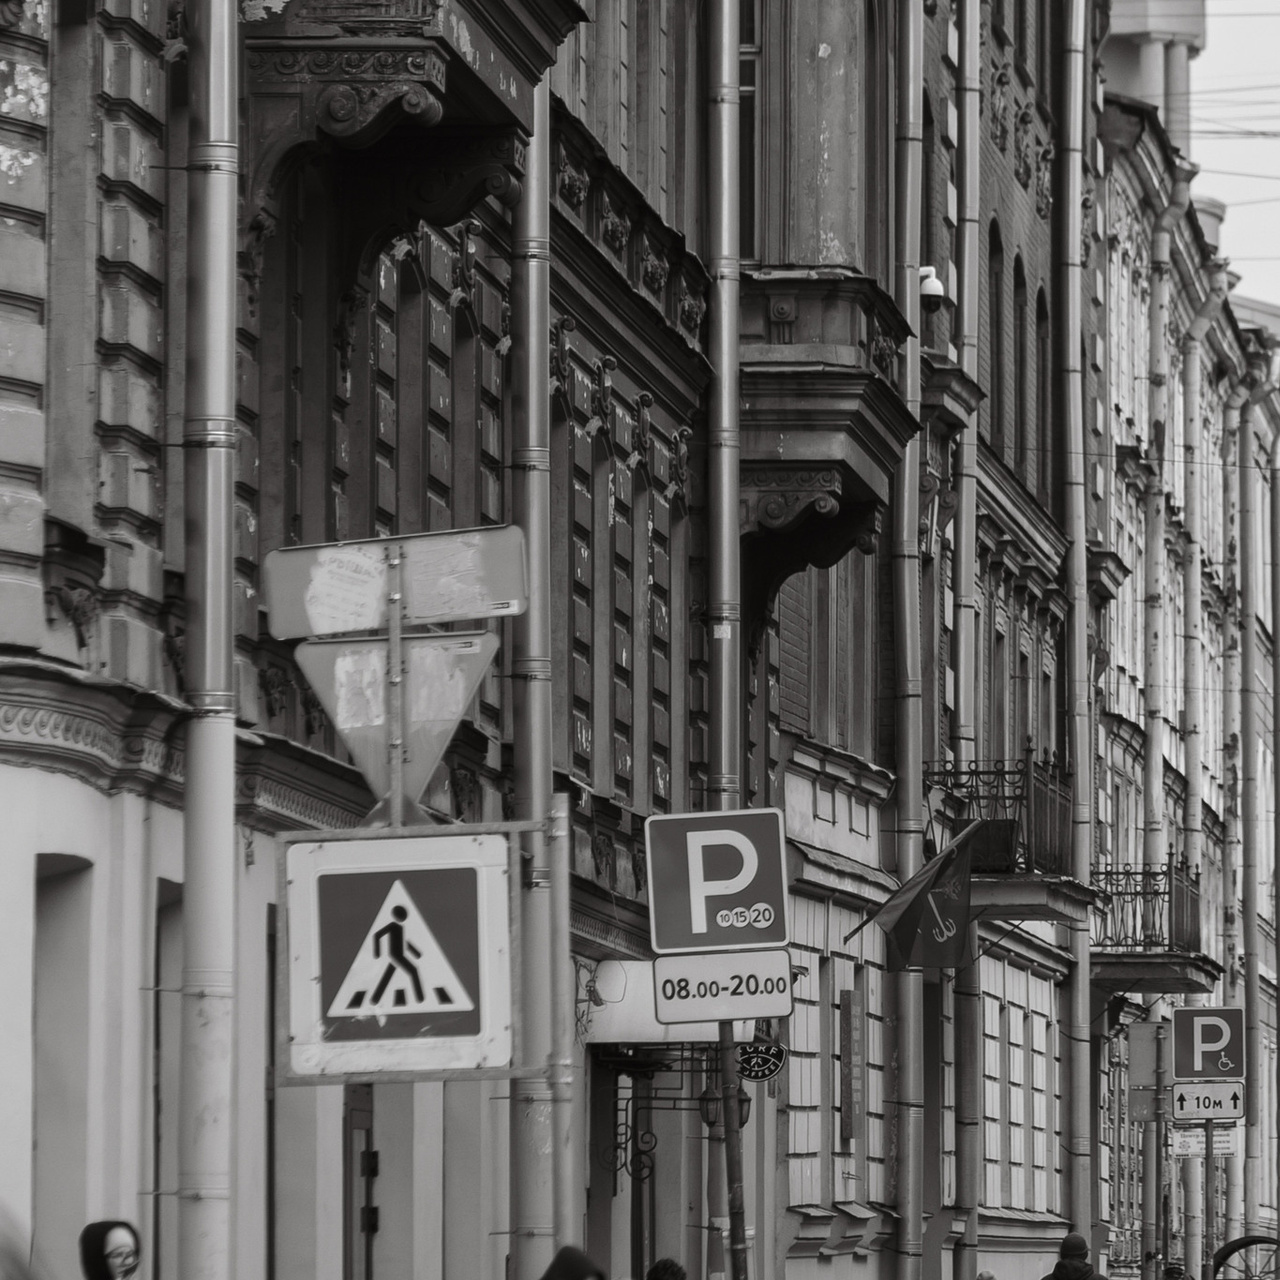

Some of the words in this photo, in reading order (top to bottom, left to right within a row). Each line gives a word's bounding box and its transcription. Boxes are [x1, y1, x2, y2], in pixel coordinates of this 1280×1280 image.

[686, 829, 759, 934] P
[719, 913, 731, 924] 10
[733, 909, 748, 924] 15
[751, 907, 773, 924] 20
[661, 973, 788, 1002] 08.00-20.00
[1193, 1016, 1232, 1071] P
